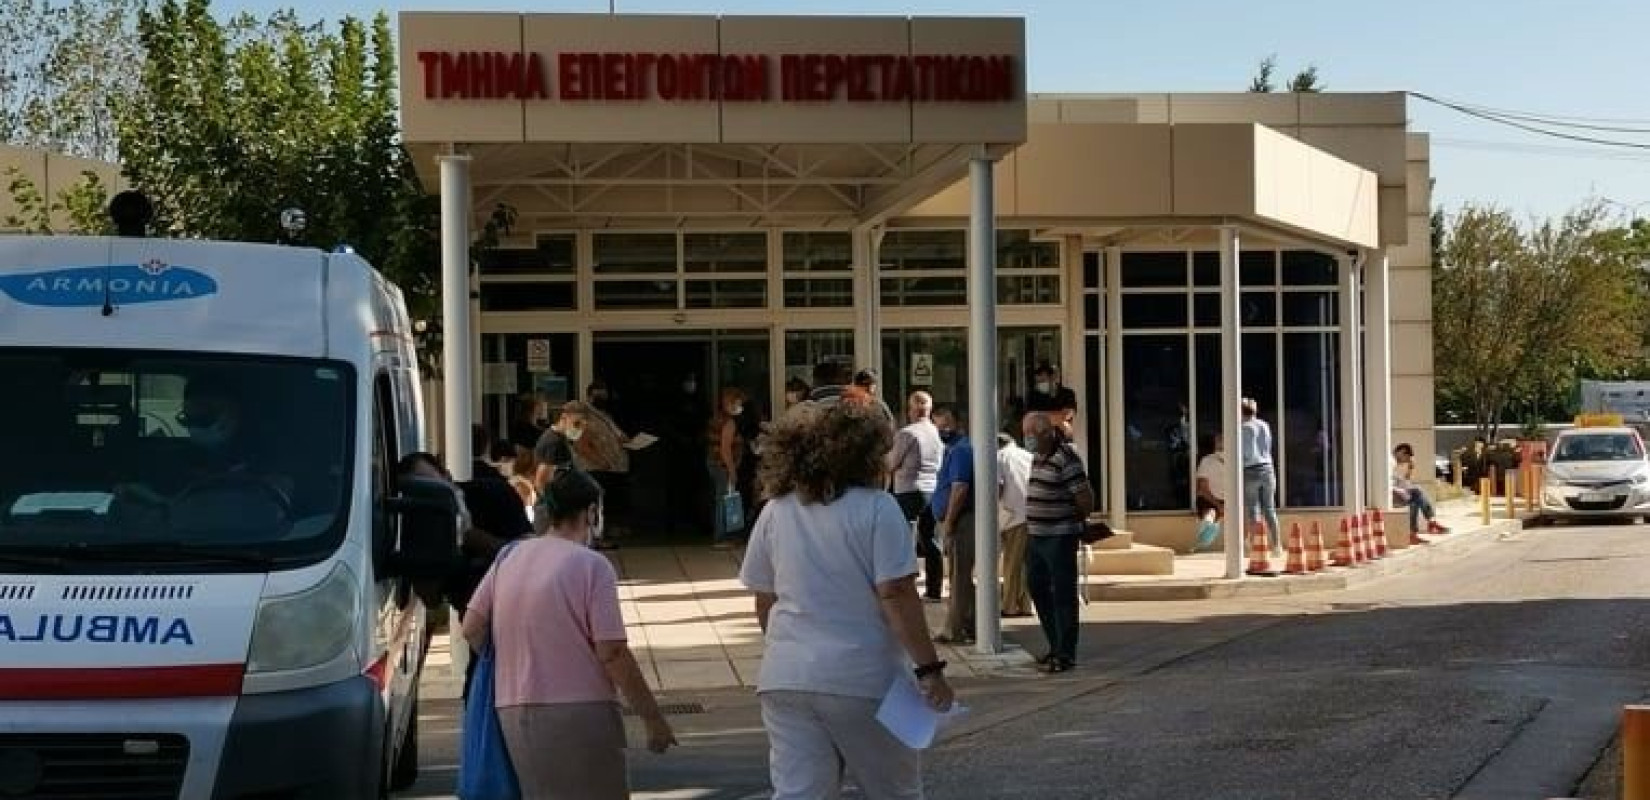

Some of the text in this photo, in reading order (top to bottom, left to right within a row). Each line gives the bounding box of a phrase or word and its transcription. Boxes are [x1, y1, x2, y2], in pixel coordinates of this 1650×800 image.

[418, 51, 1014, 103] ΤΜΗΜΑ ΕΠΕΙΓΟΝΤΩΝ ΠΕΡΙΣΤΑΤΙΚΩΝ
[26, 277, 194, 295] ARMONIA
